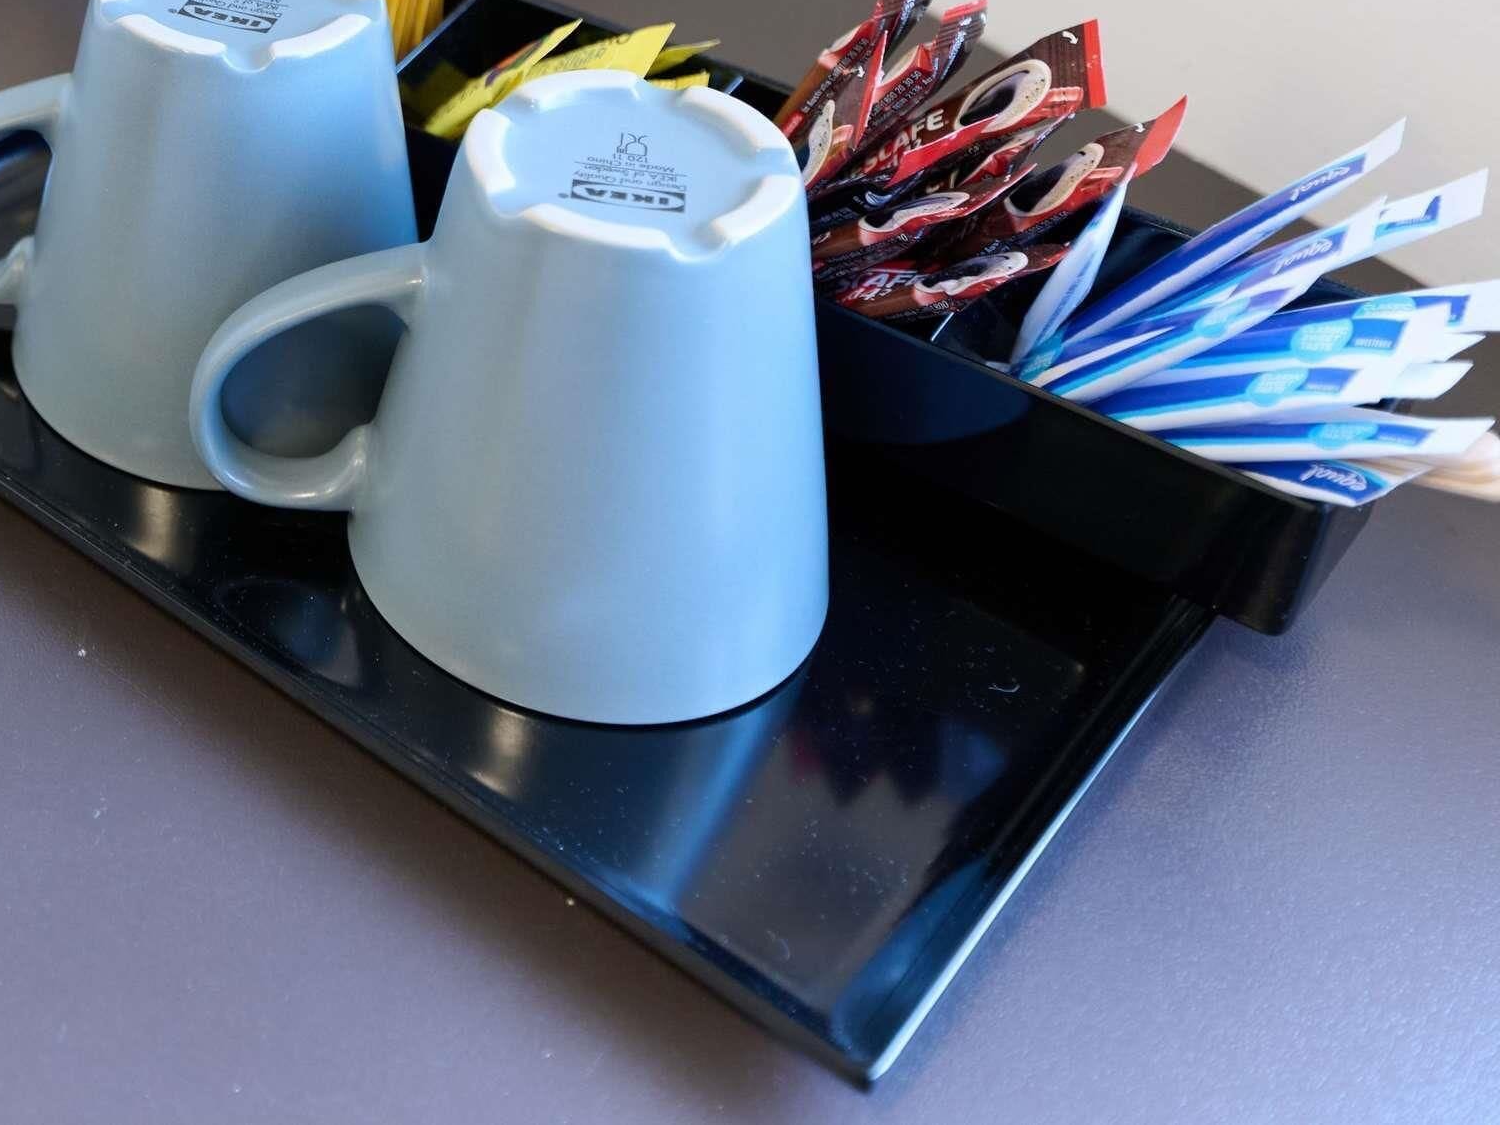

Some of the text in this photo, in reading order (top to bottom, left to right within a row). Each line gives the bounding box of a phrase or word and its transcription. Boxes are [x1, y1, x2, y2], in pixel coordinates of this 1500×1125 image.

[194, 7, 261, 27] IKEA
[585, 188, 668, 205] IKEA
[1299, 463, 1367, 492] equal
